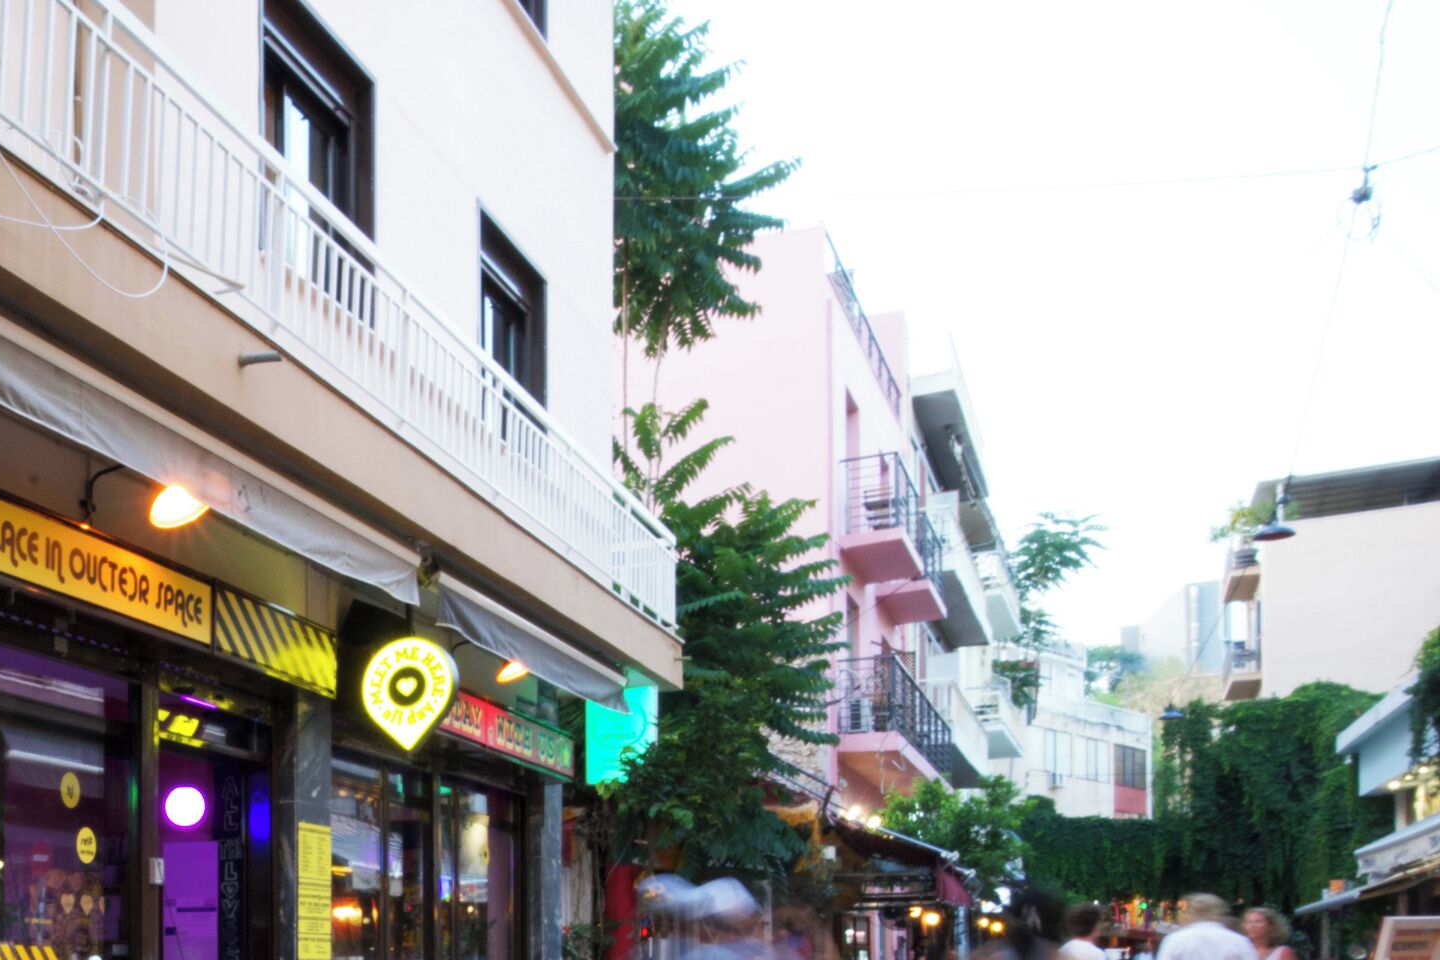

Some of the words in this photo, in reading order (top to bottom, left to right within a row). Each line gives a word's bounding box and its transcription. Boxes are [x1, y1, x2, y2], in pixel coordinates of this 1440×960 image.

[45, 537, 65, 584] IN
[155, 582, 203, 628] SPACE
[370, 657, 392, 705] MEET
[394, 646, 419, 663] ME
[421, 652, 446, 698] HERE
[496, 714, 532, 757] WITH
[537, 731, 555, 765] US
